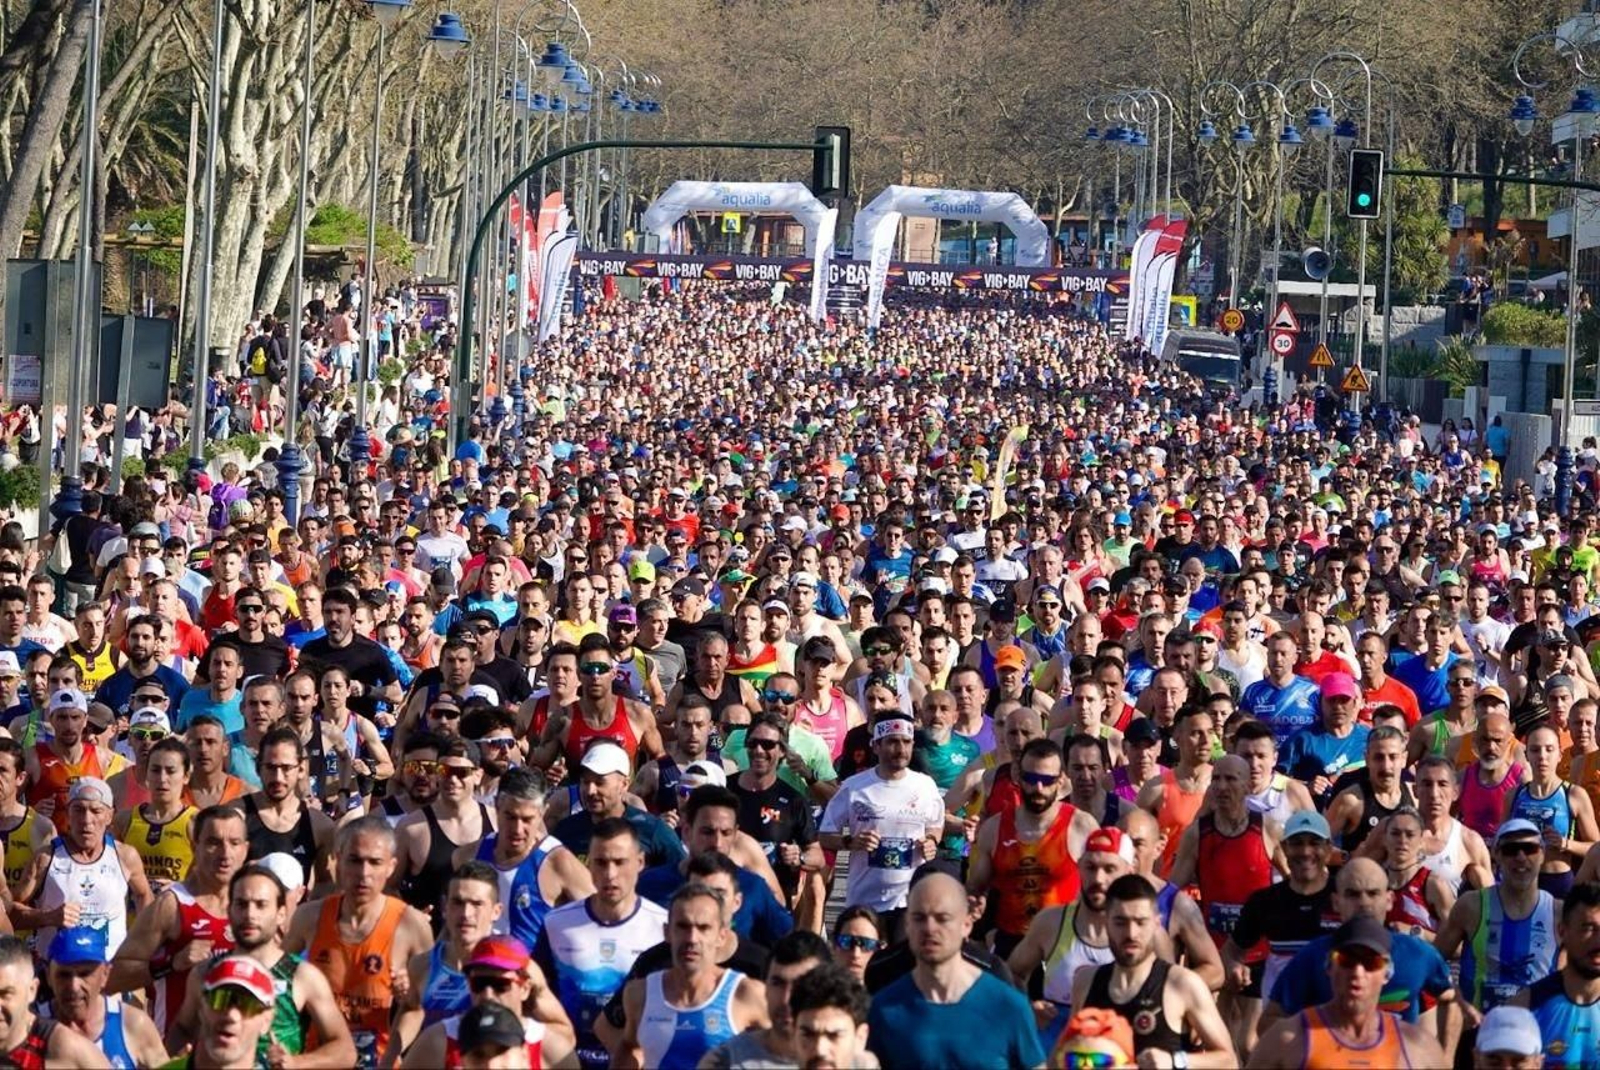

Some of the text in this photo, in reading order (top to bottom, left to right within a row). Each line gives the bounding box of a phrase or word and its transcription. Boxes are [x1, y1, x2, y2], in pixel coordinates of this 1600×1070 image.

[722, 193, 771, 206] aqualia
[931, 201, 982, 215] aqualia
[1225, 316, 1239, 324] 20
[1277, 340, 1290, 348] 30
[326, 760, 337, 771] 14
[884, 854, 900, 867] 34
